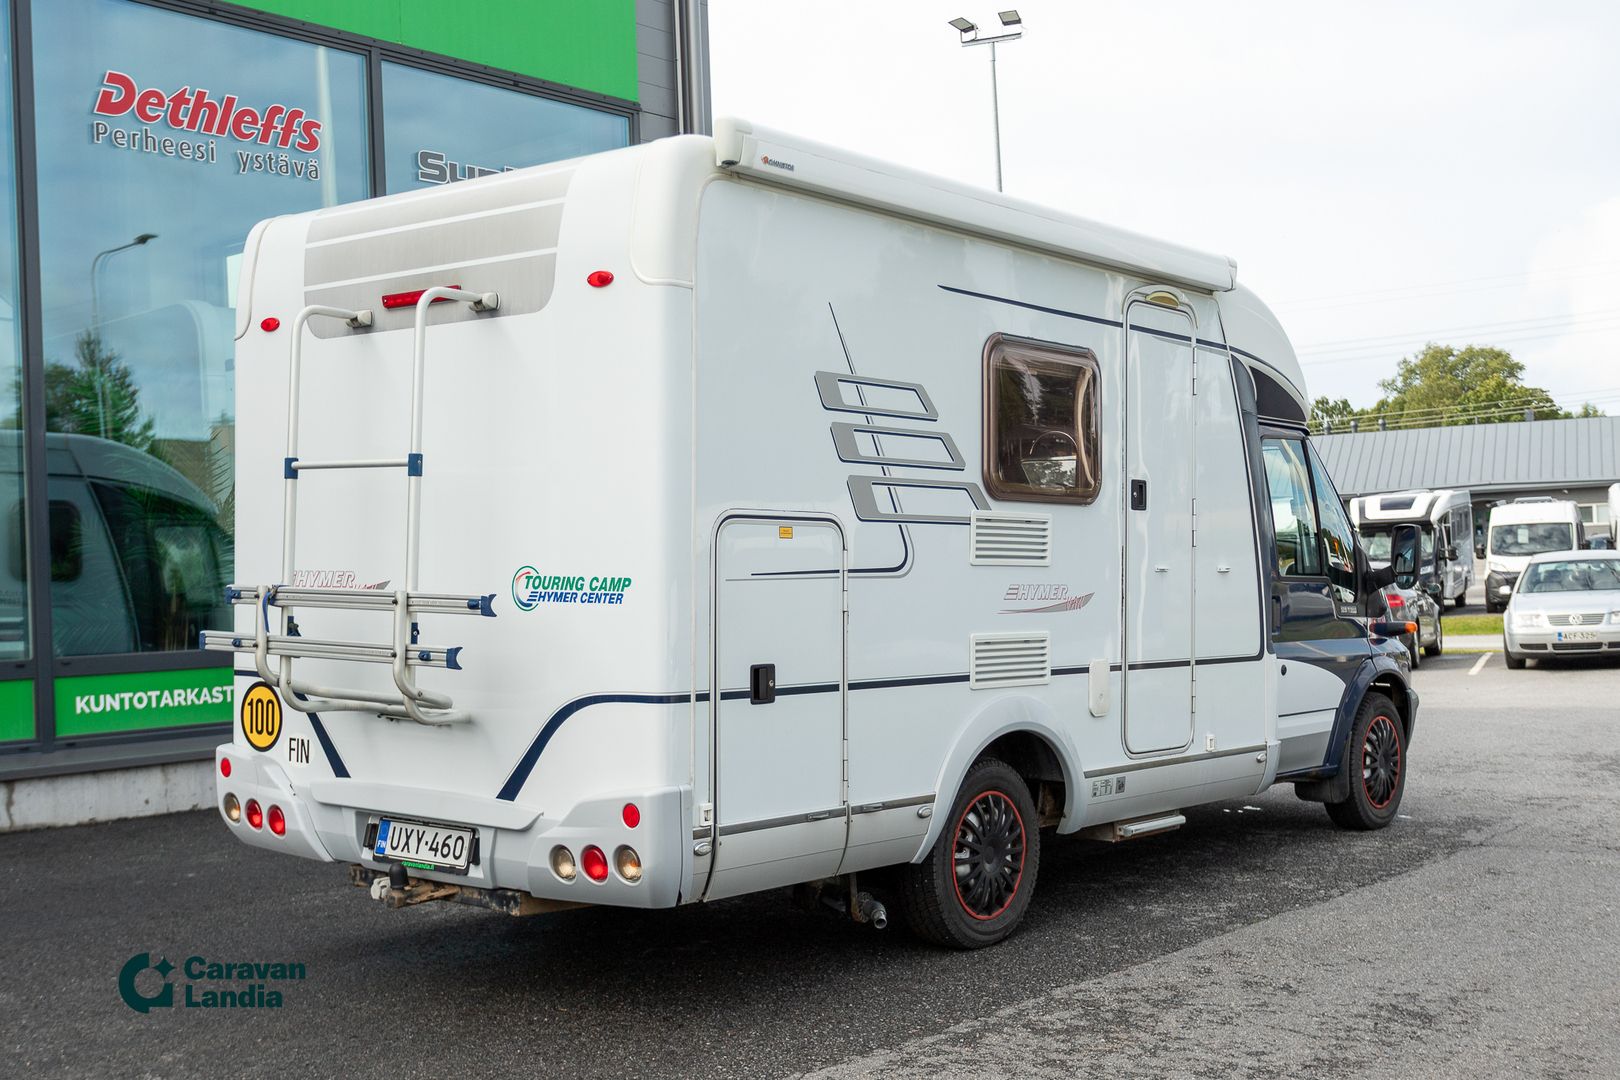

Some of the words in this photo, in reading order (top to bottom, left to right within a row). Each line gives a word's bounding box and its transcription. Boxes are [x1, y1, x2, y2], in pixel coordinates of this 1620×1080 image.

[94, 70, 322, 152] Dethleffs
[94, 121, 216, 163] Perheesi
[237, 150, 320, 180] ystävä
[295, 570, 355, 588] HYMER
[525, 575, 585, 591] TOURING
[589, 576, 632, 592] CAMP
[1017, 584, 1068, 600] HYMER
[537, 591, 578, 603] HYMER
[580, 592, 624, 604] CENTER
[76, 686, 234, 714] KUNTOTARKAST
[247, 698, 275, 737] 100
[288, 737, 310, 764] FIN
[390, 826, 465, 860] UXY-460
